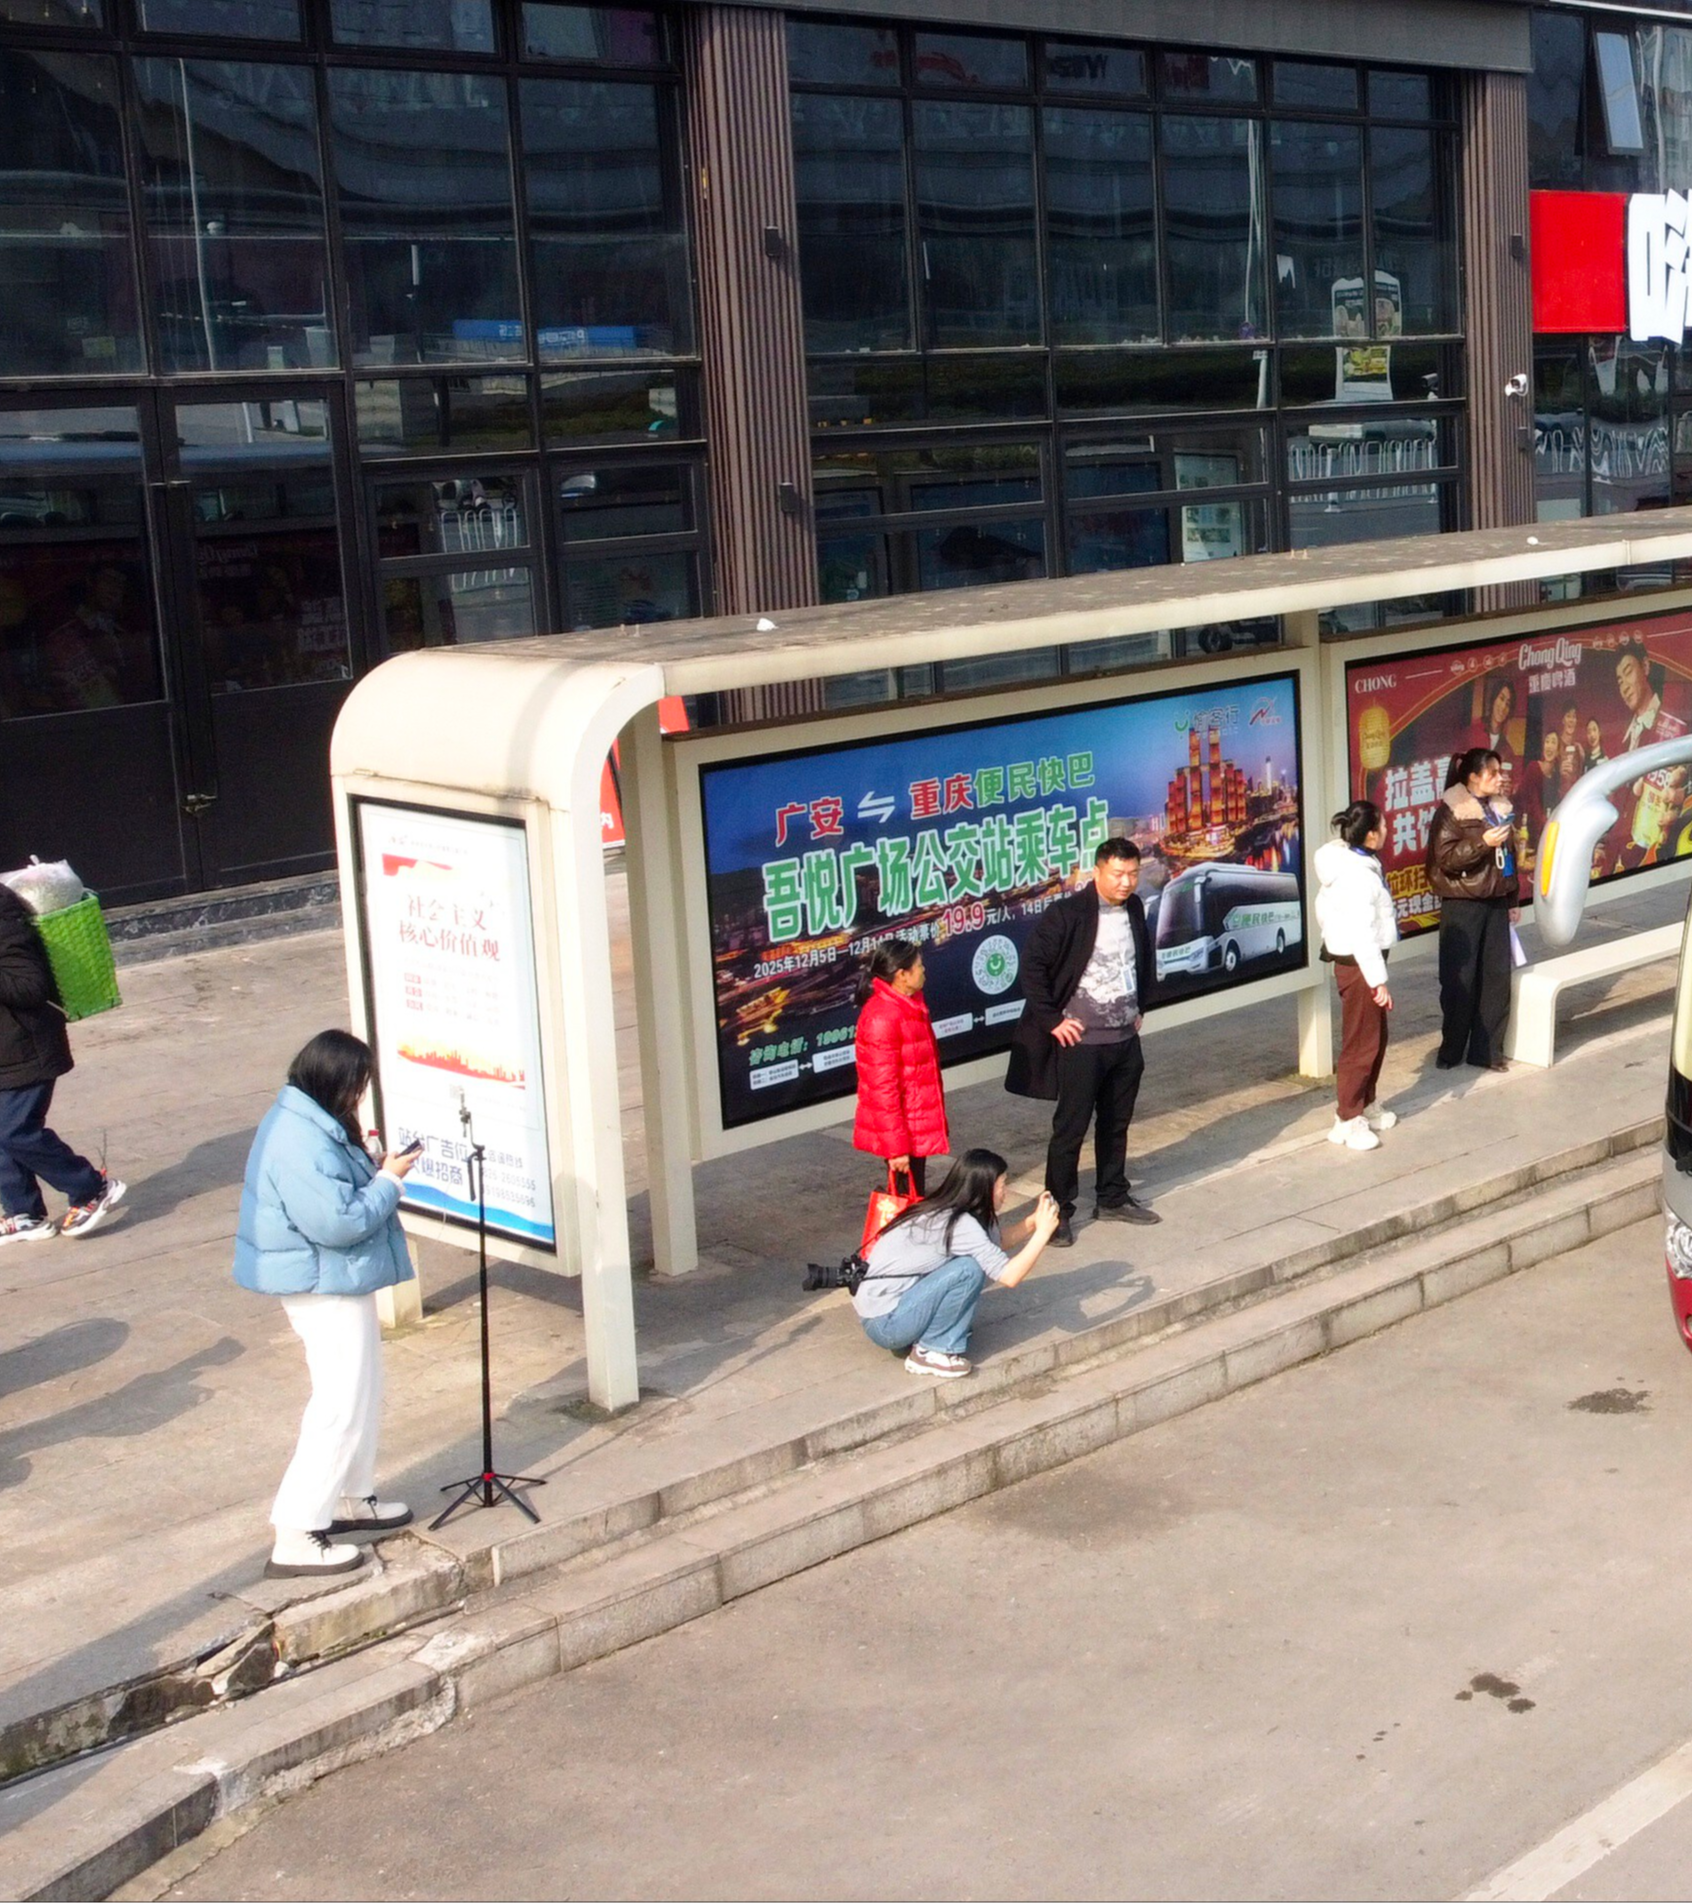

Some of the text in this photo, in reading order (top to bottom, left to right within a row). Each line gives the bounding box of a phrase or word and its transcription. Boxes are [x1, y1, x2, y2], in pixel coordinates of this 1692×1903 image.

[1354, 674, 1397, 694] CHONG
[775, 797, 844, 847] 广安
[762, 797, 1110, 943] 吾悦广场公交站乘车点
[408, 894, 487, 931] 社会主义
[399, 920, 501, 962] 核心价值观
